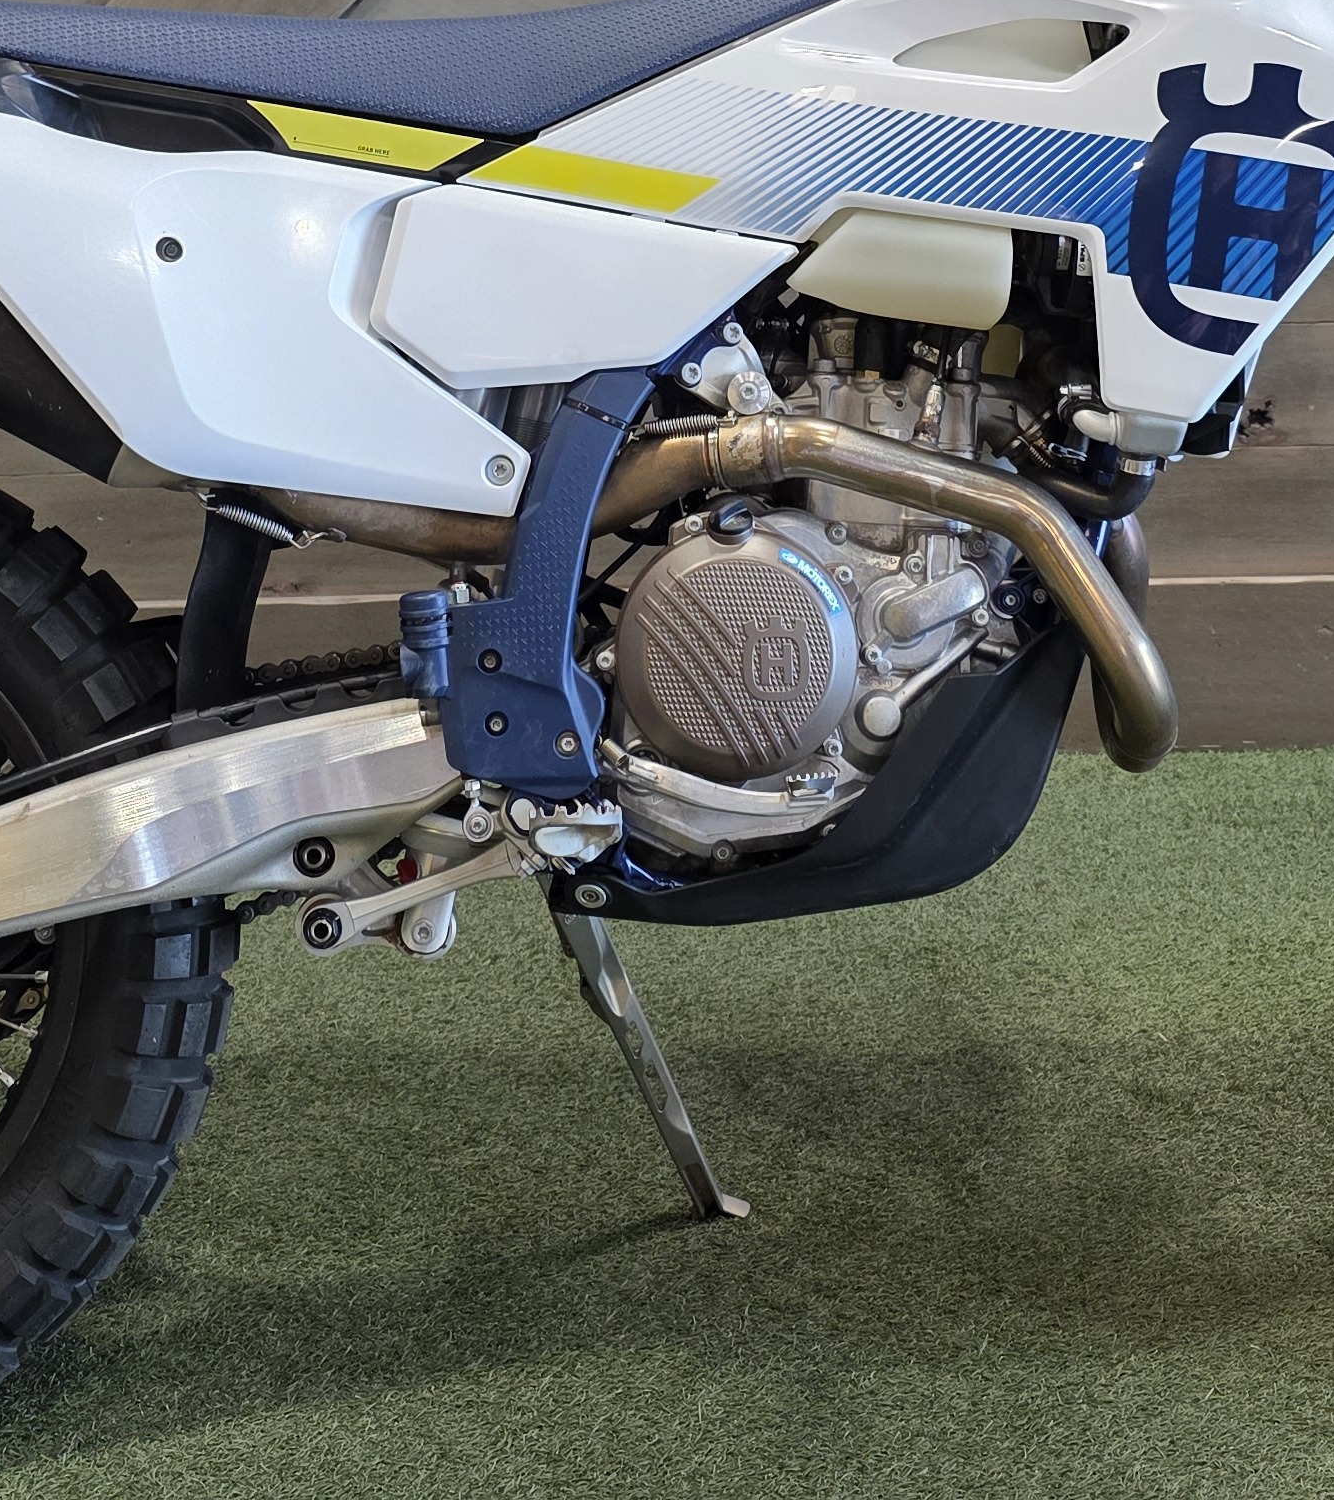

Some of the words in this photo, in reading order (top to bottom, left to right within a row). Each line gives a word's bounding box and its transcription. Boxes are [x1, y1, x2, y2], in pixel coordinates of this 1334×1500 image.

[357, 145, 374, 153] GRAB
[374, 147, 390, 156] HERE
[797, 559, 841, 612] MOTOREX
